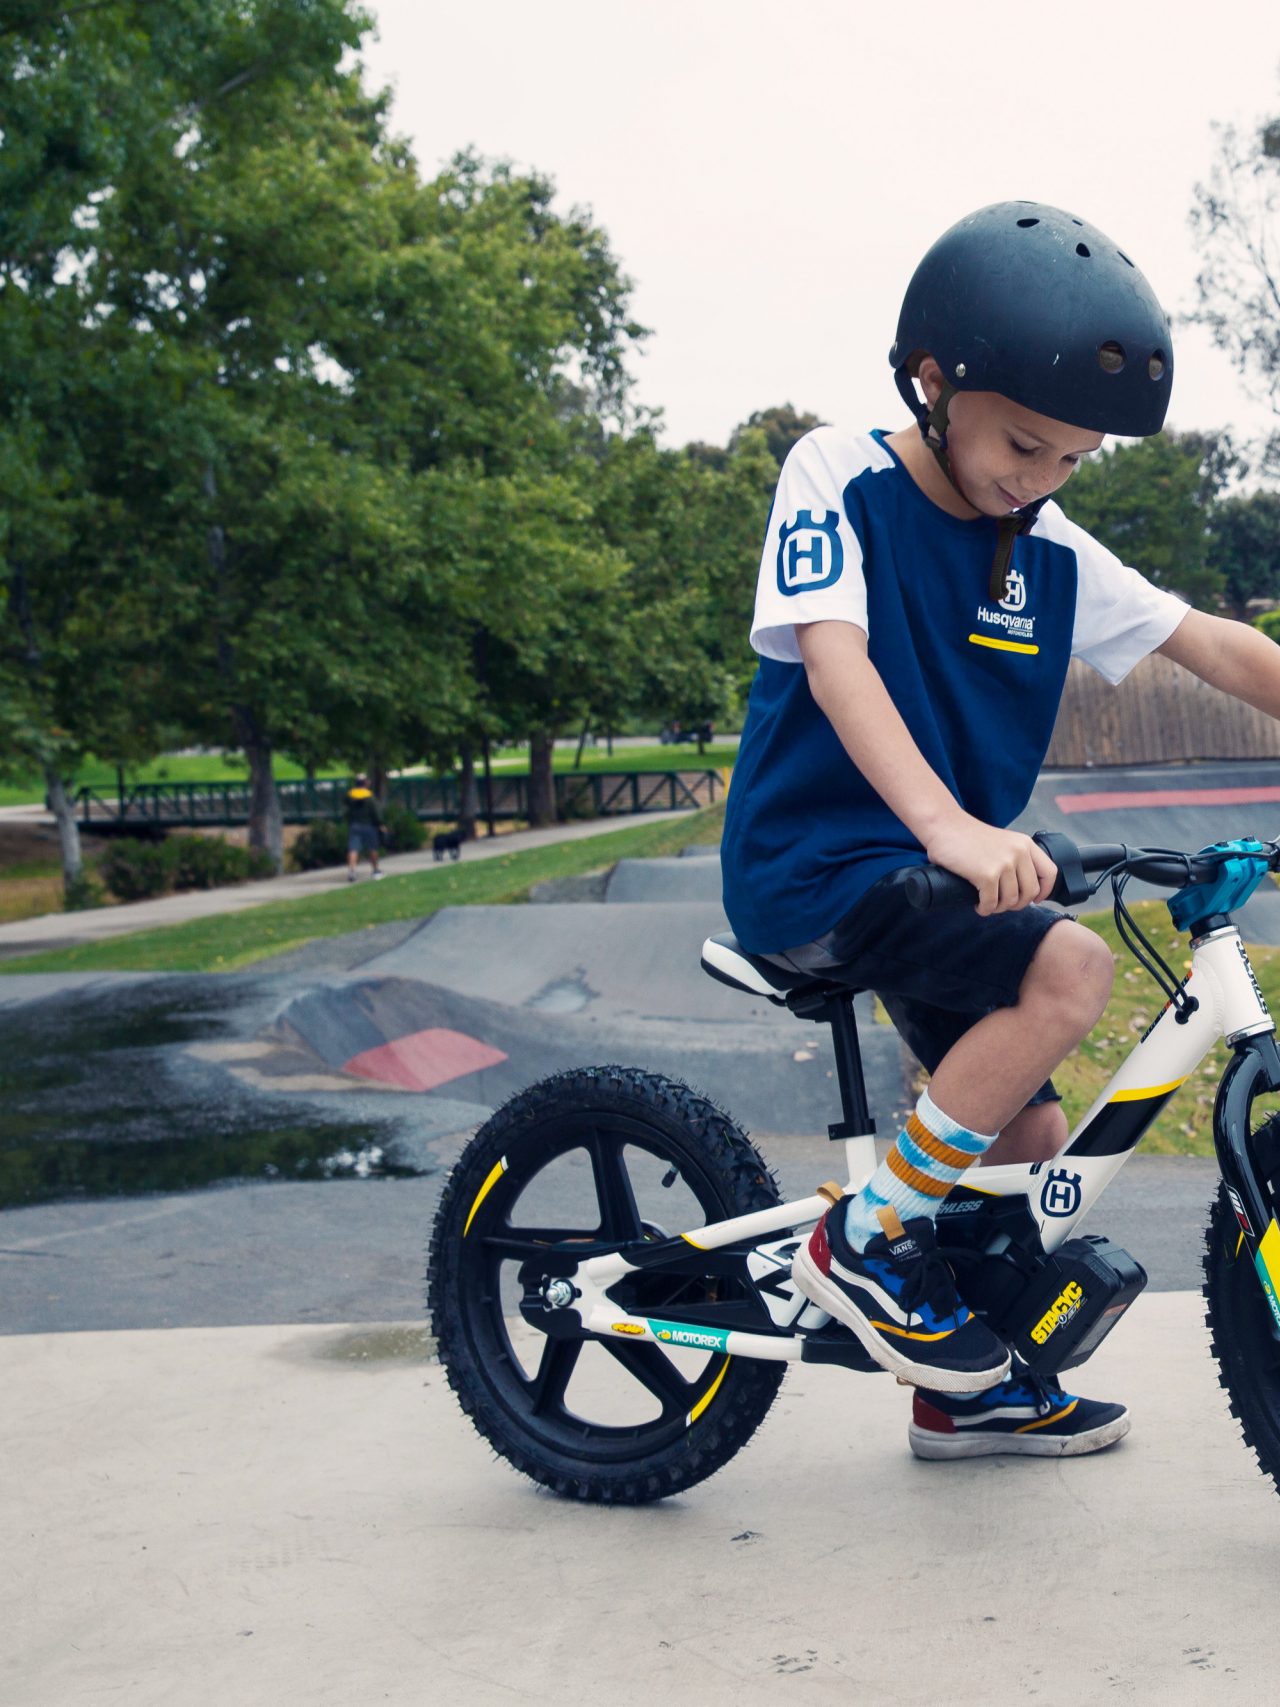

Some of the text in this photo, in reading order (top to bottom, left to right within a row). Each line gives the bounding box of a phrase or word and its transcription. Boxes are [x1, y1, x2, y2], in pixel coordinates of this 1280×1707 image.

[889, 1239, 914, 1256] VANS
[1030, 1281, 1083, 1345] STACYC
[672, 1330, 723, 1348] MOTOREX
